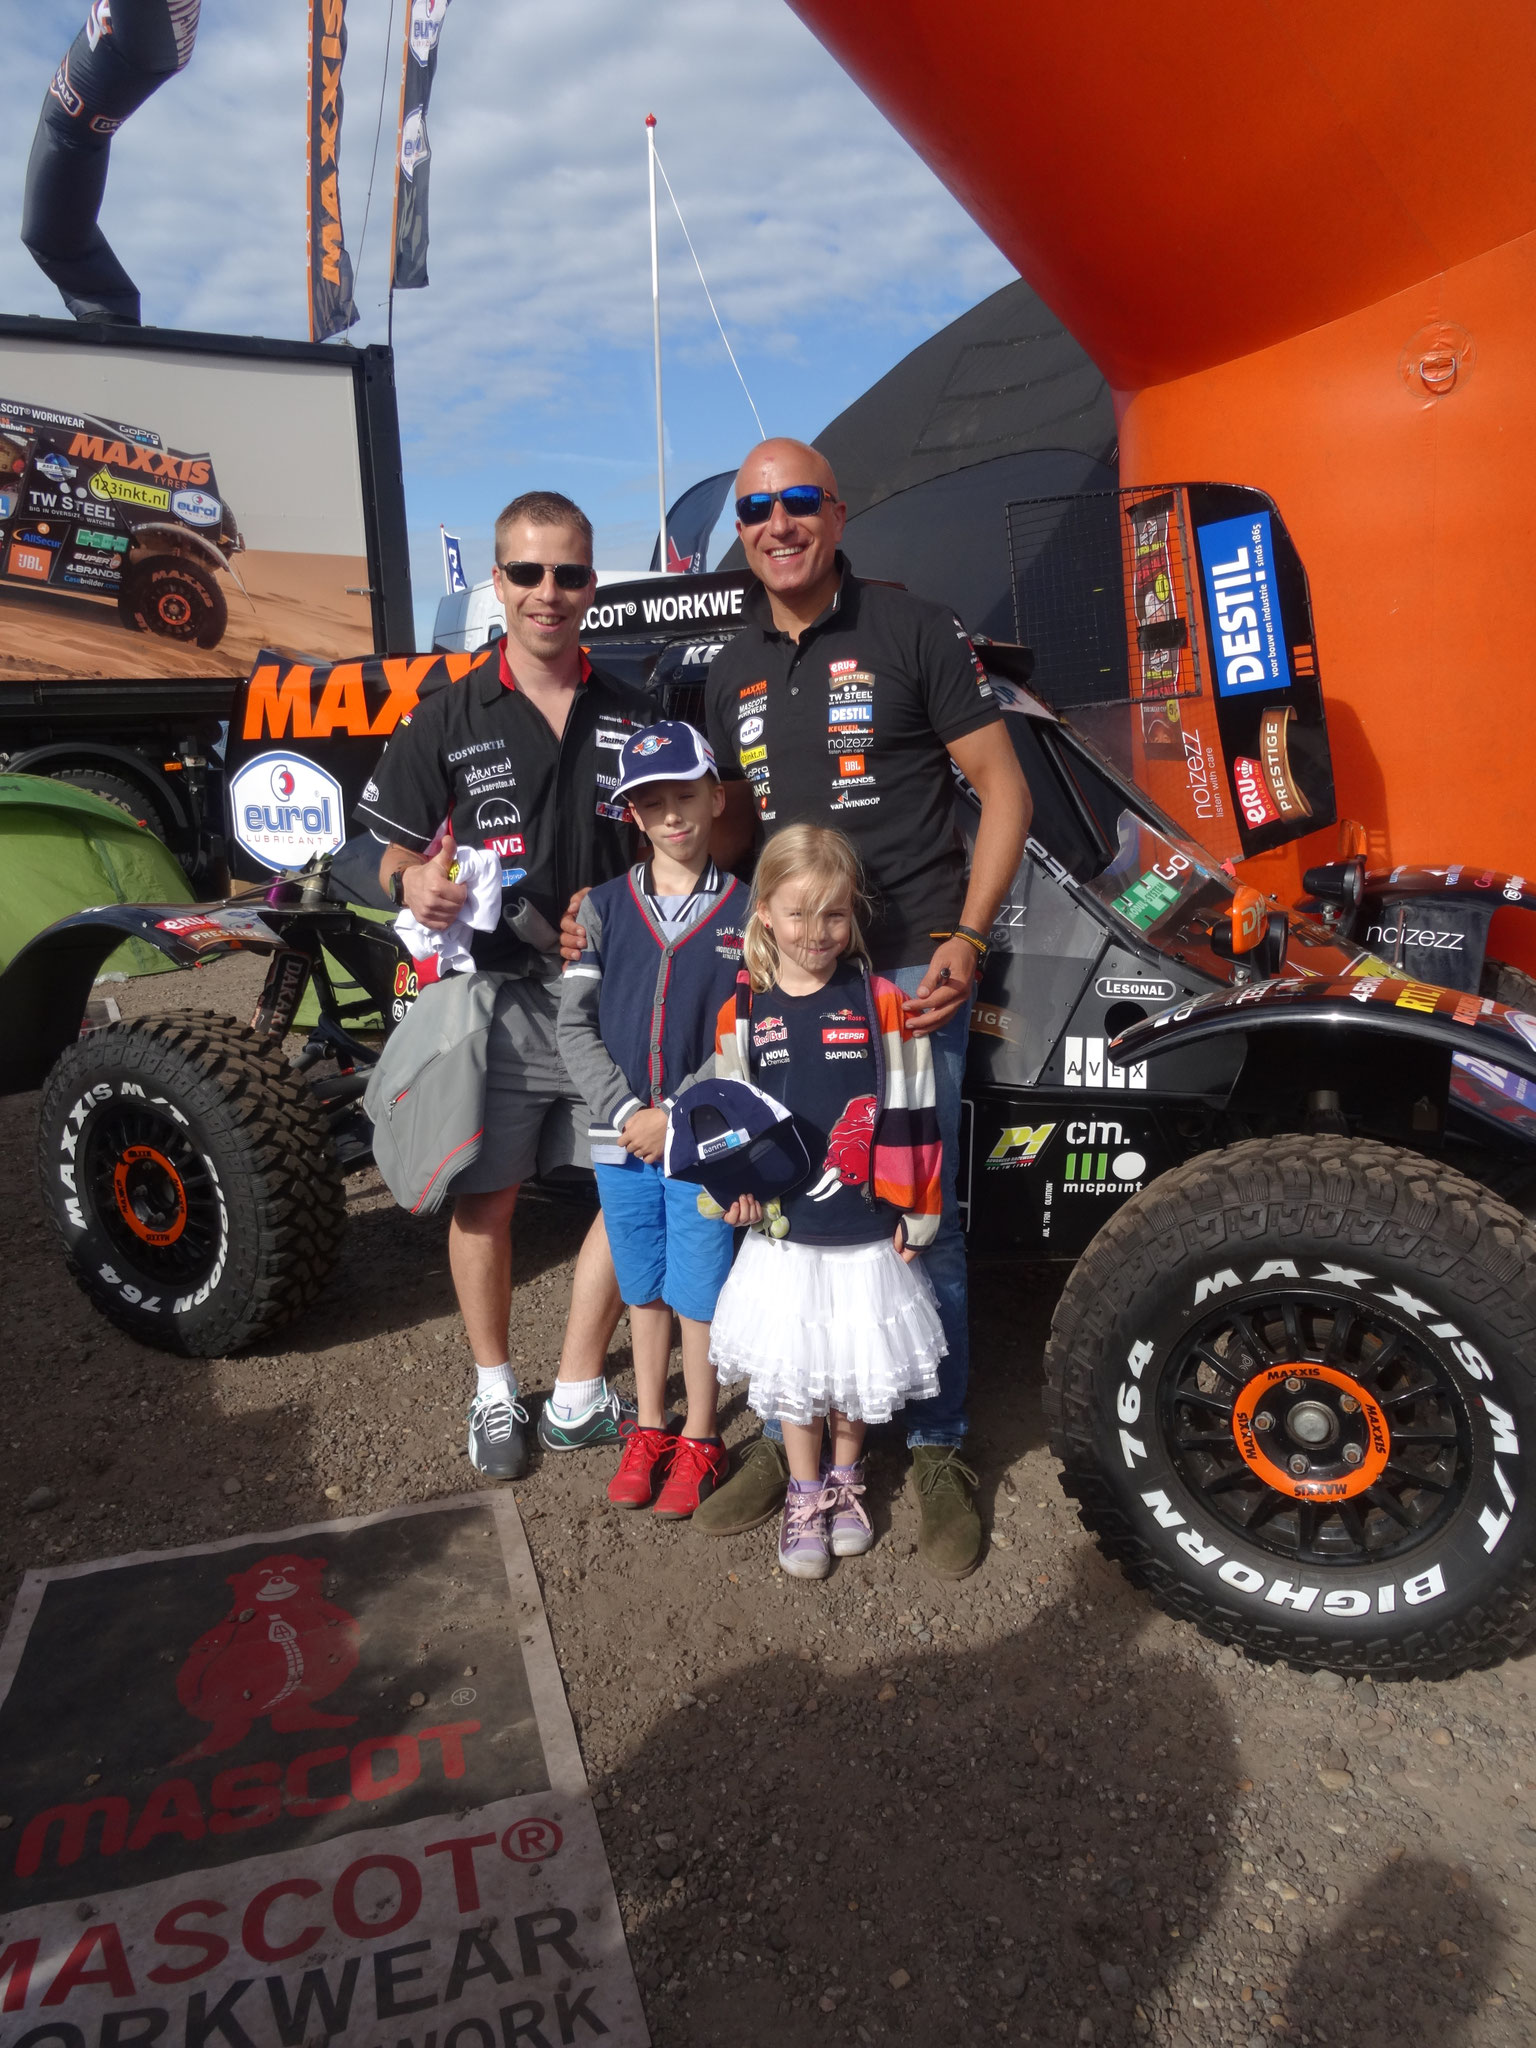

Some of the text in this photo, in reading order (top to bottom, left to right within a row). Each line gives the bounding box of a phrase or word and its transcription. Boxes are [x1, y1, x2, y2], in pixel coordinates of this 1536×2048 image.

[32, 409, 85, 428] WORKWEAR
[119, 425, 159, 440] GoPro
[68, 432, 211, 485] MAXXIS
[94, 478, 167, 507] 123inkt.nl
[154, 476, 187, 490] TYRES
[30, 491, 116, 521] TW STEEL
[177, 500, 217, 518] eurol
[19, 554, 43, 572] JBL
[1251, 523, 1279, 678] voor bouw en industrie sinds 1865
[1211, 547, 1265, 685] DESTIL
[834, 674, 870, 683] PRESTIGE
[740, 680, 767, 699] MAXXIS
[829, 693, 843, 702] TW
[831, 707, 870, 722] DESTIL
[742, 724, 760, 738] eurol
[448, 739, 505, 763] COSWORTH
[828, 736, 874, 749] noizezz
[845, 761, 861, 772] JBL
[1181, 728, 1214, 819] noizezz
[1266, 722, 1293, 812] PRESTIGE
[1206, 746, 1224, 818] listen with care
[830, 797, 881, 811] van WINKOOP
[244, 797, 332, 835] eurol
[481, 814, 516, 830] MAN
[491, 838, 523, 856] JVC
[190, 927, 264, 942] PRESTIGE
[716, 926, 734, 937] SLAM
[1366, 923, 1466, 951] noizezz
[266, 959, 300, 1026] DAKAR
[753, 1027, 787, 1047] Red Bull
[838, 1032, 865, 1040] CEPSA
[766, 1049, 789, 1060] NOVA
[767, 1057, 791, 1066] Chemicals
[825, 1051, 862, 1060] SAPINDA
[60, 1082, 114, 1230] MAXXIS
[1063, 1182, 1143, 1196] micpoint
[172, 1153, 230, 1315] BIGHORN
[99, 1262, 162, 1314] 764
[1194, 1259, 1494, 1383] MAXXIS
[1267, 1366, 1321, 1382] MAXXIS
[1116, 1338, 1158, 1469] 764
[1236, 1411, 1258, 1460] MAXXIS
[1365, 1403, 1387, 1455] MAXXIS
[1294, 1483, 1348, 1497] MAXXIS
[1140, 1488, 1448, 1618] BIGHORN
[14, 1720, 482, 1879] MASCOT
